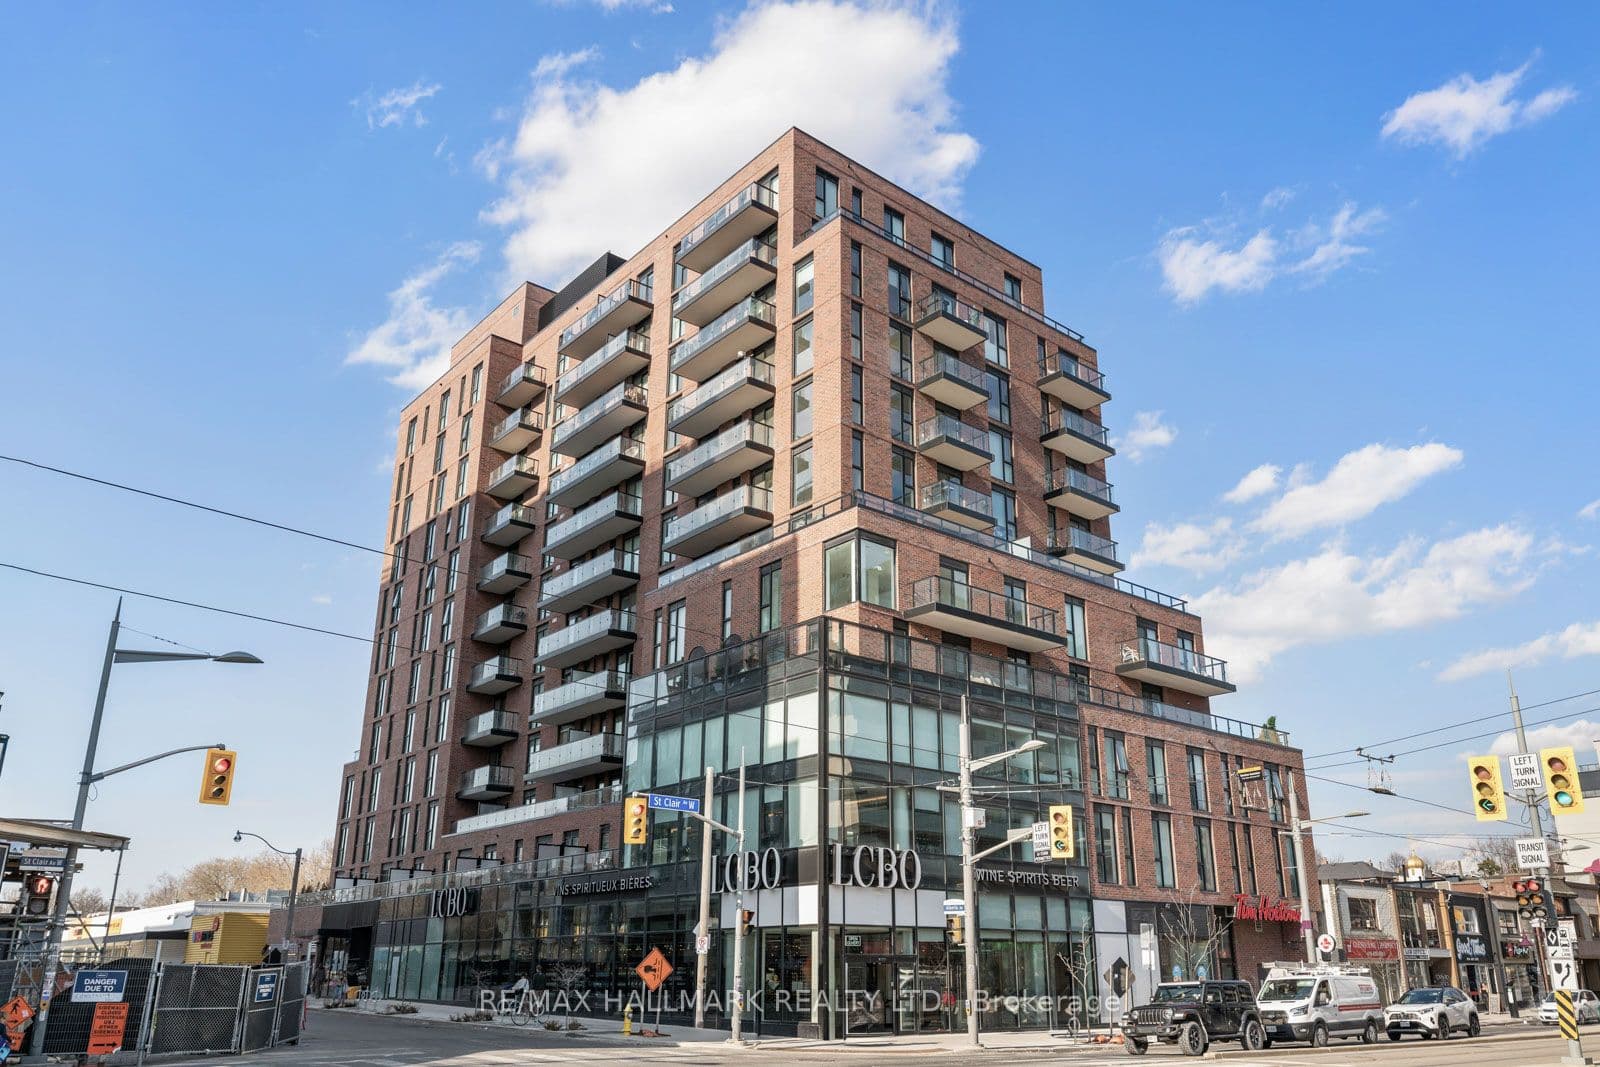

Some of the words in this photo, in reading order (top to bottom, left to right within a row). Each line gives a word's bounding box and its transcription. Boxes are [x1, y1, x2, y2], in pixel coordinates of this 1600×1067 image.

[1513, 755, 1532, 766] LEFT
[1515, 766, 1535, 777] TURN
[1513, 777, 1540, 788] SIGNAL
[653, 796, 662, 806] St
[663, 797, 680, 808] Clair
[688, 800, 695, 809] W
[1034, 823, 1047, 832] LEFT
[1035, 832, 1049, 840] TURN
[1035, 841, 1049, 849] SIGNAL
[1517, 842, 1544, 852] TRANSIT
[32, 857, 49, 866] Clair
[1521, 853, 1545, 864] SIGNAL
[711, 847, 780, 894] LCBO
[832, 842, 921, 890] LCBO
[975, 868, 1005, 882] WINE
[1007, 870, 1049, 885] SPIRITS
[1051, 873, 1080, 887] BEER
[571, 879, 617, 895] SPIRITUEUX
[431, 887, 467, 918] LCBO
[1233, 894, 1257, 920] Tim
